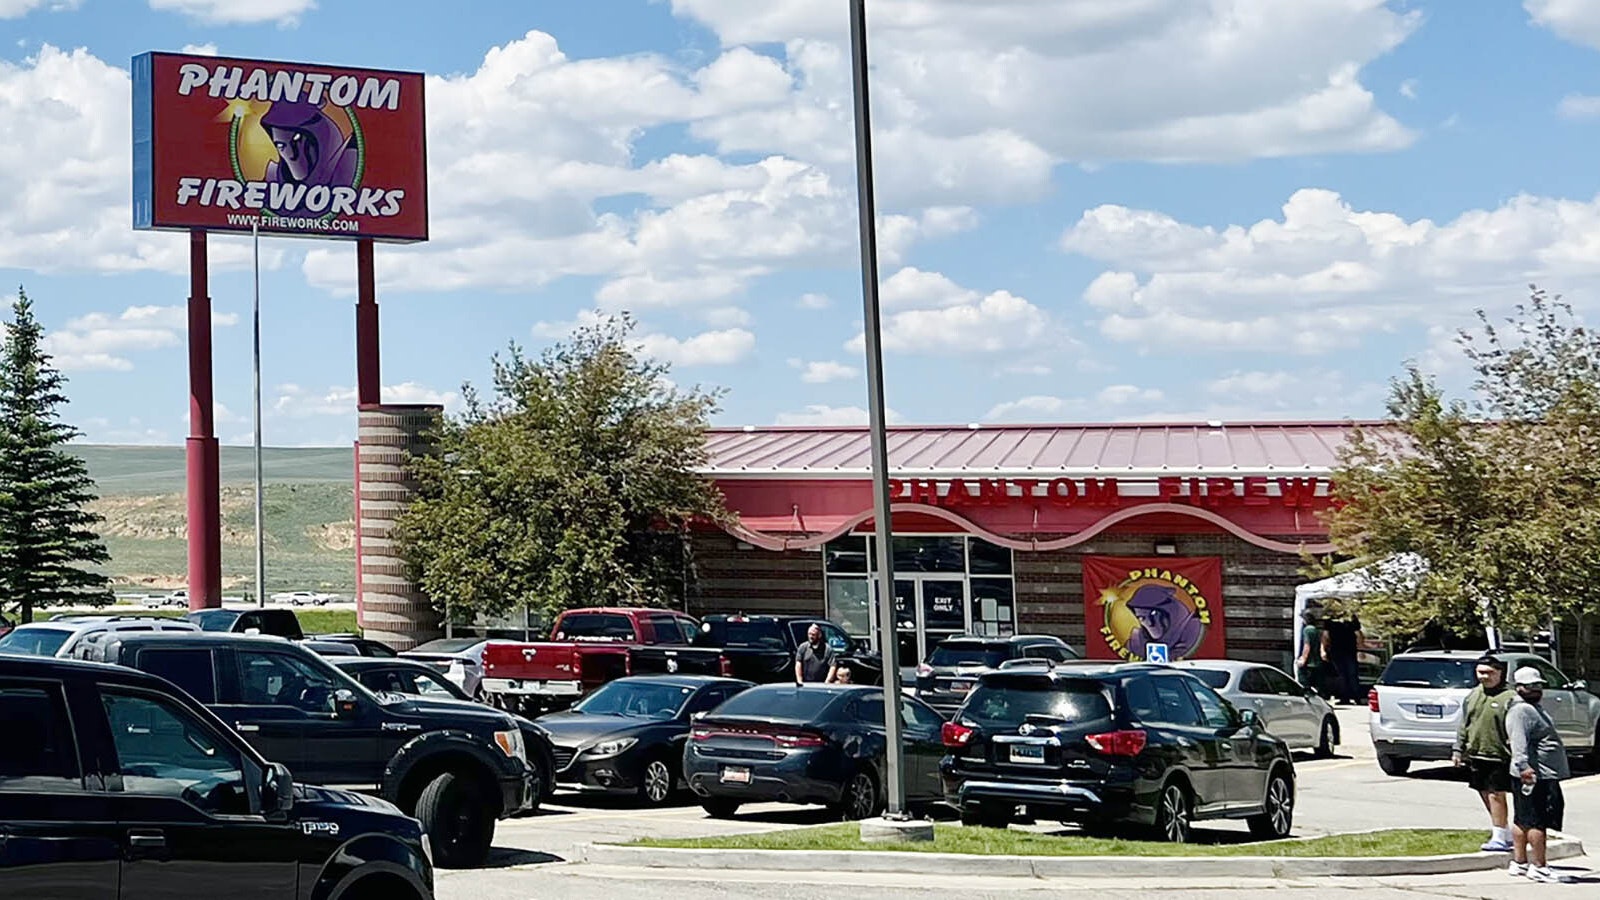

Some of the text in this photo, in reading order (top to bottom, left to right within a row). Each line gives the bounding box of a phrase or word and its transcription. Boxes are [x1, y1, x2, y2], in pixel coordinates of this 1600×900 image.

[177, 63, 400, 110] PHANTOM
[176, 178, 405, 217] FIREWORKS
[227, 213, 360, 232] WWW.FIREWORKS.COM
[1157, 475, 1346, 507] FIREW
[1128, 567, 1211, 624] PHANTOM
